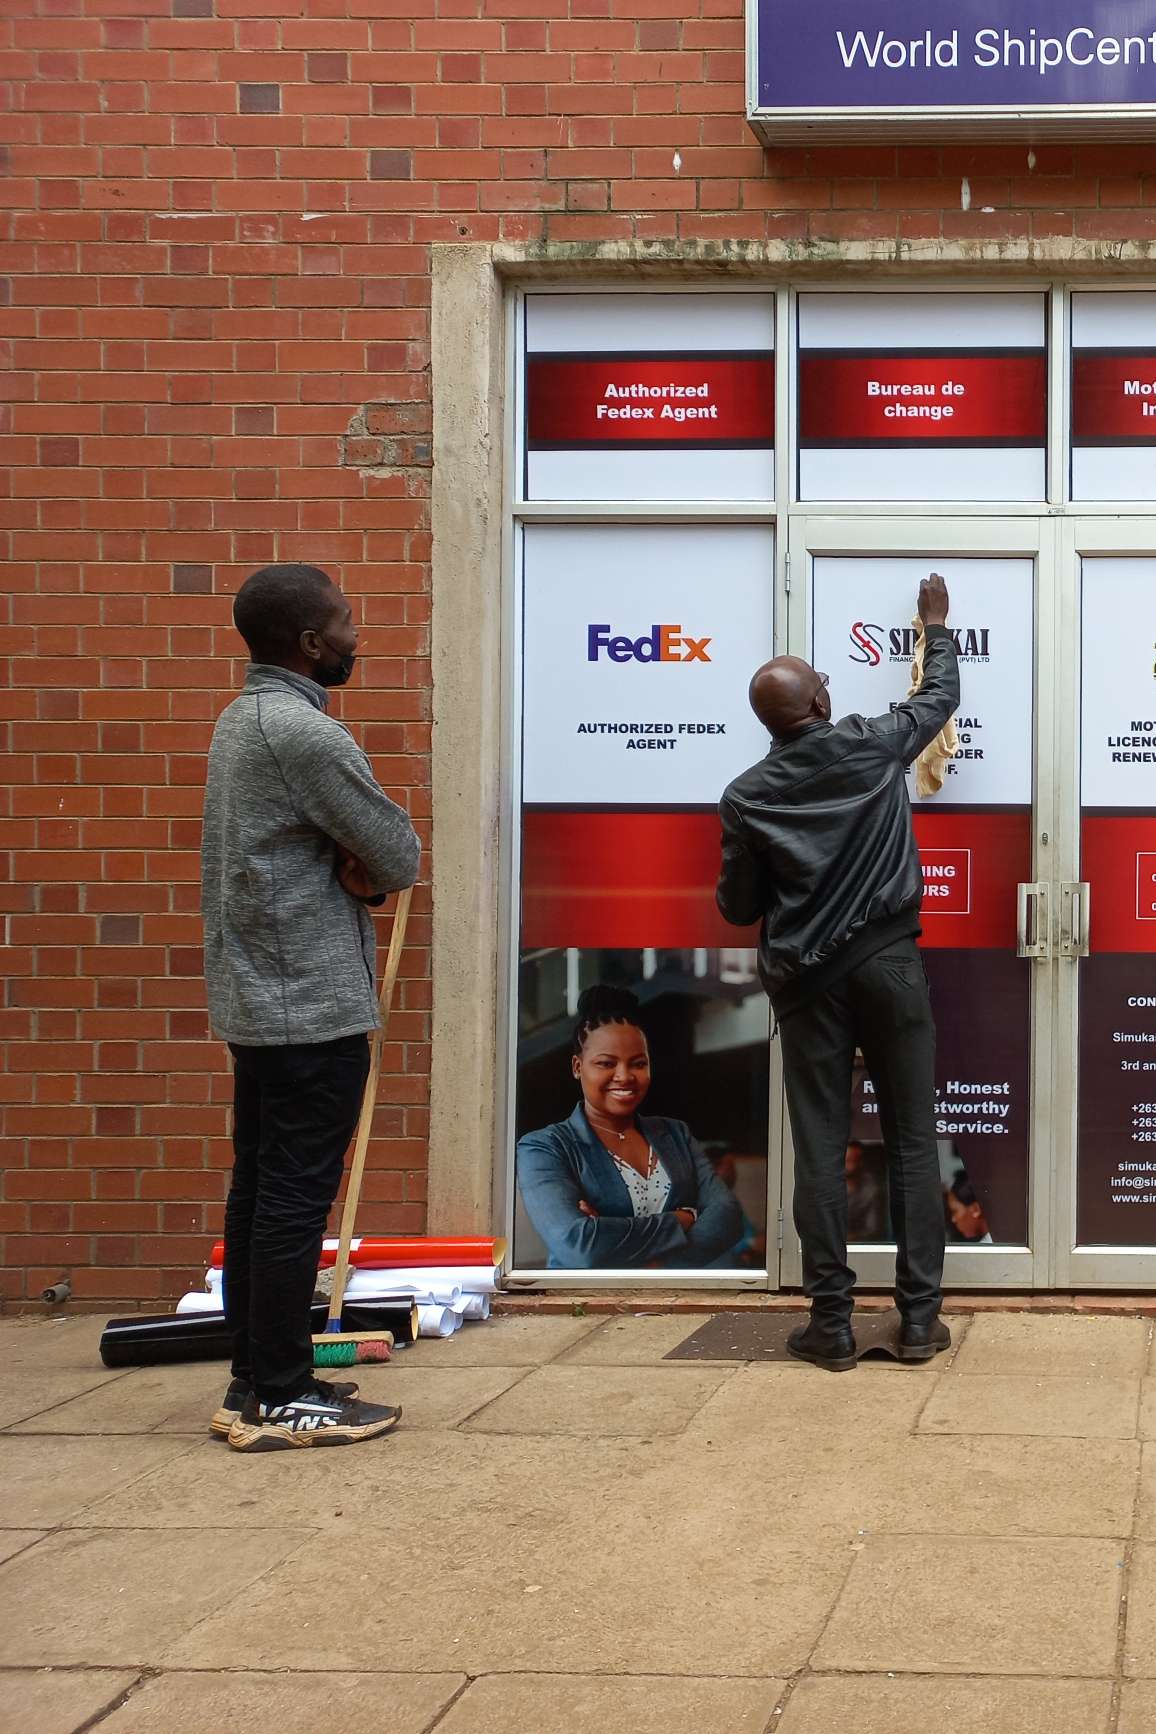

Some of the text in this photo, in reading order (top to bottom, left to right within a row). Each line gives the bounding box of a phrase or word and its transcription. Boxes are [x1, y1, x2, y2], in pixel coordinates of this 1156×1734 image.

[836, 30, 958, 68] World
[604, 383, 709, 398] Authorized
[867, 380, 965, 396] Bureau de
[596, 404, 718, 422] Fedex Agent
[884, 402, 954, 420] change
[587, 624, 713, 663] FedEx
[959, 656, 976, 664] (PVT)
[576, 723, 727, 735] AUTHORIZED FEDEX
[625, 739, 677, 750] AGENT
[1120, 1060, 1140, 1071] 3rd
[946, 1081, 1010, 1095] Honest
[936, 1120, 1009, 1134] Service.
